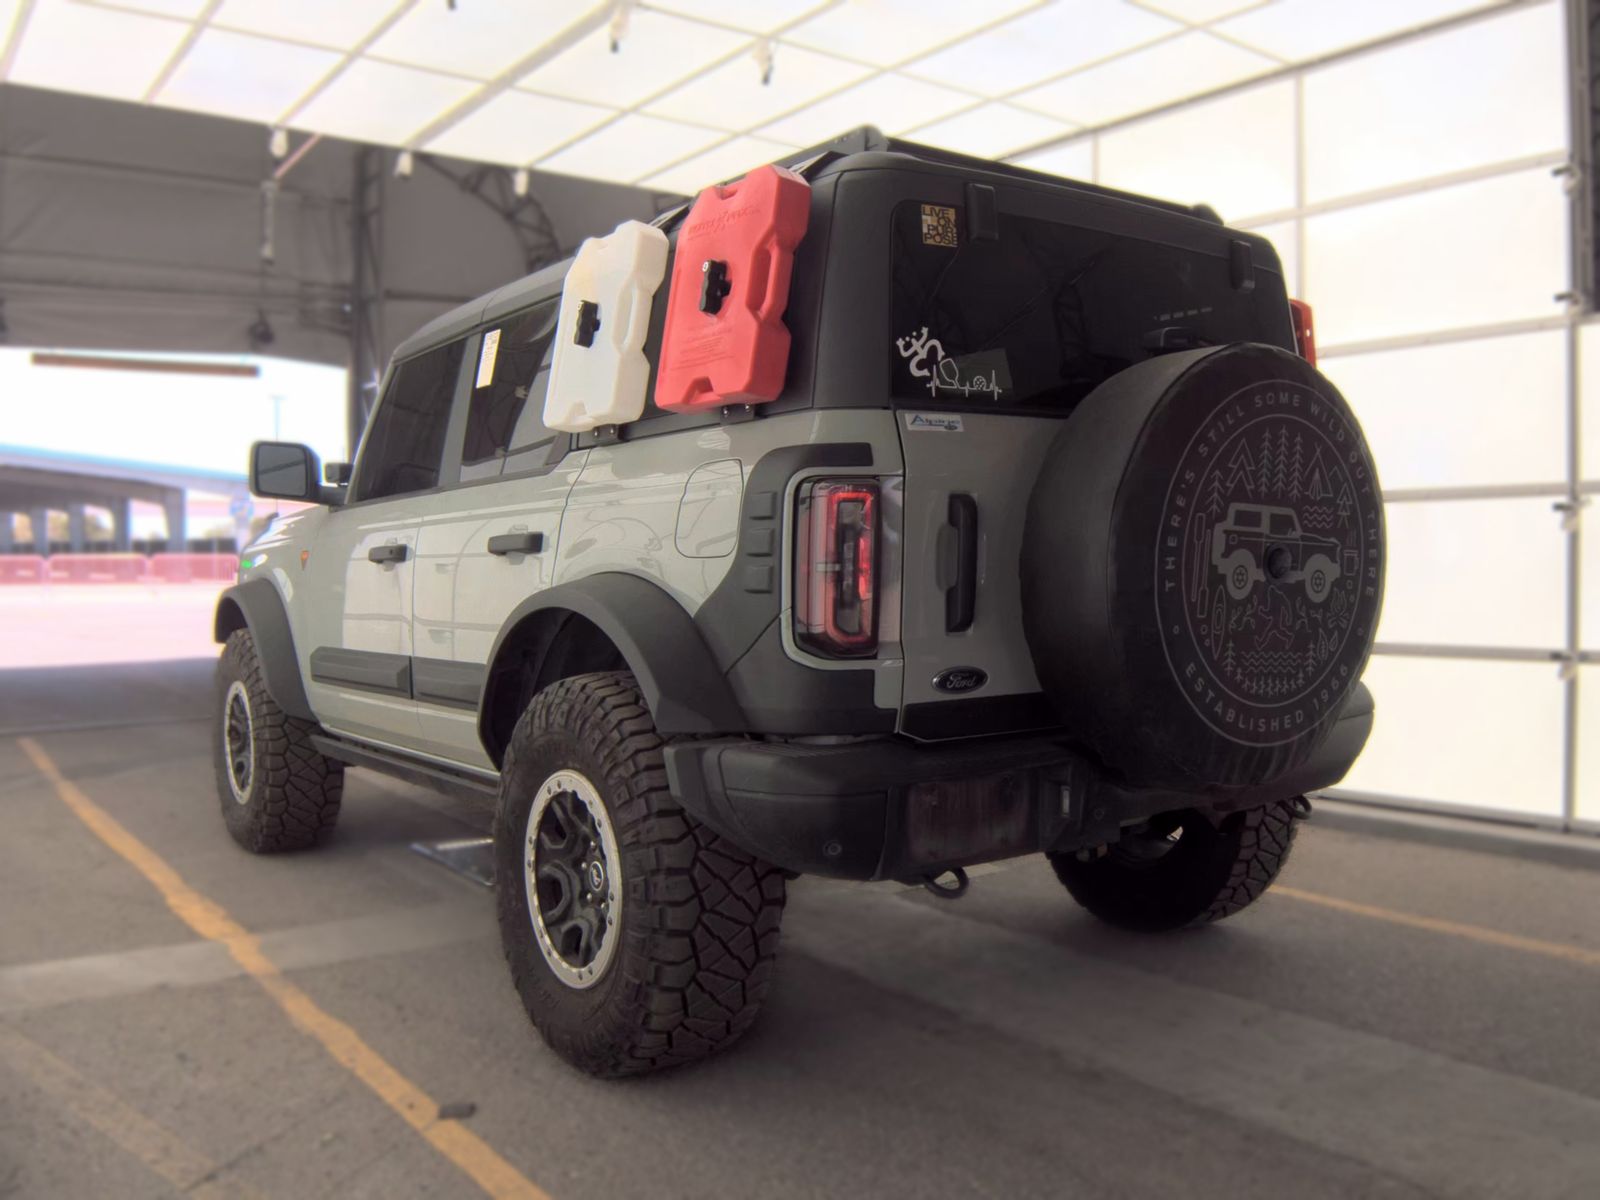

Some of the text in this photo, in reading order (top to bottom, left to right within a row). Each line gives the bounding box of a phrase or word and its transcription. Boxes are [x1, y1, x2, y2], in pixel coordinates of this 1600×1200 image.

[922, 206, 950, 217] LIVE
[924, 232, 958, 245] POSE
[1165, 391, 1377, 597] THERE'S STILL SOME WILD OUT THERE
[946, 672, 977, 689] Ford
[1185, 661, 1348, 732] ESTABLISHED 1966
